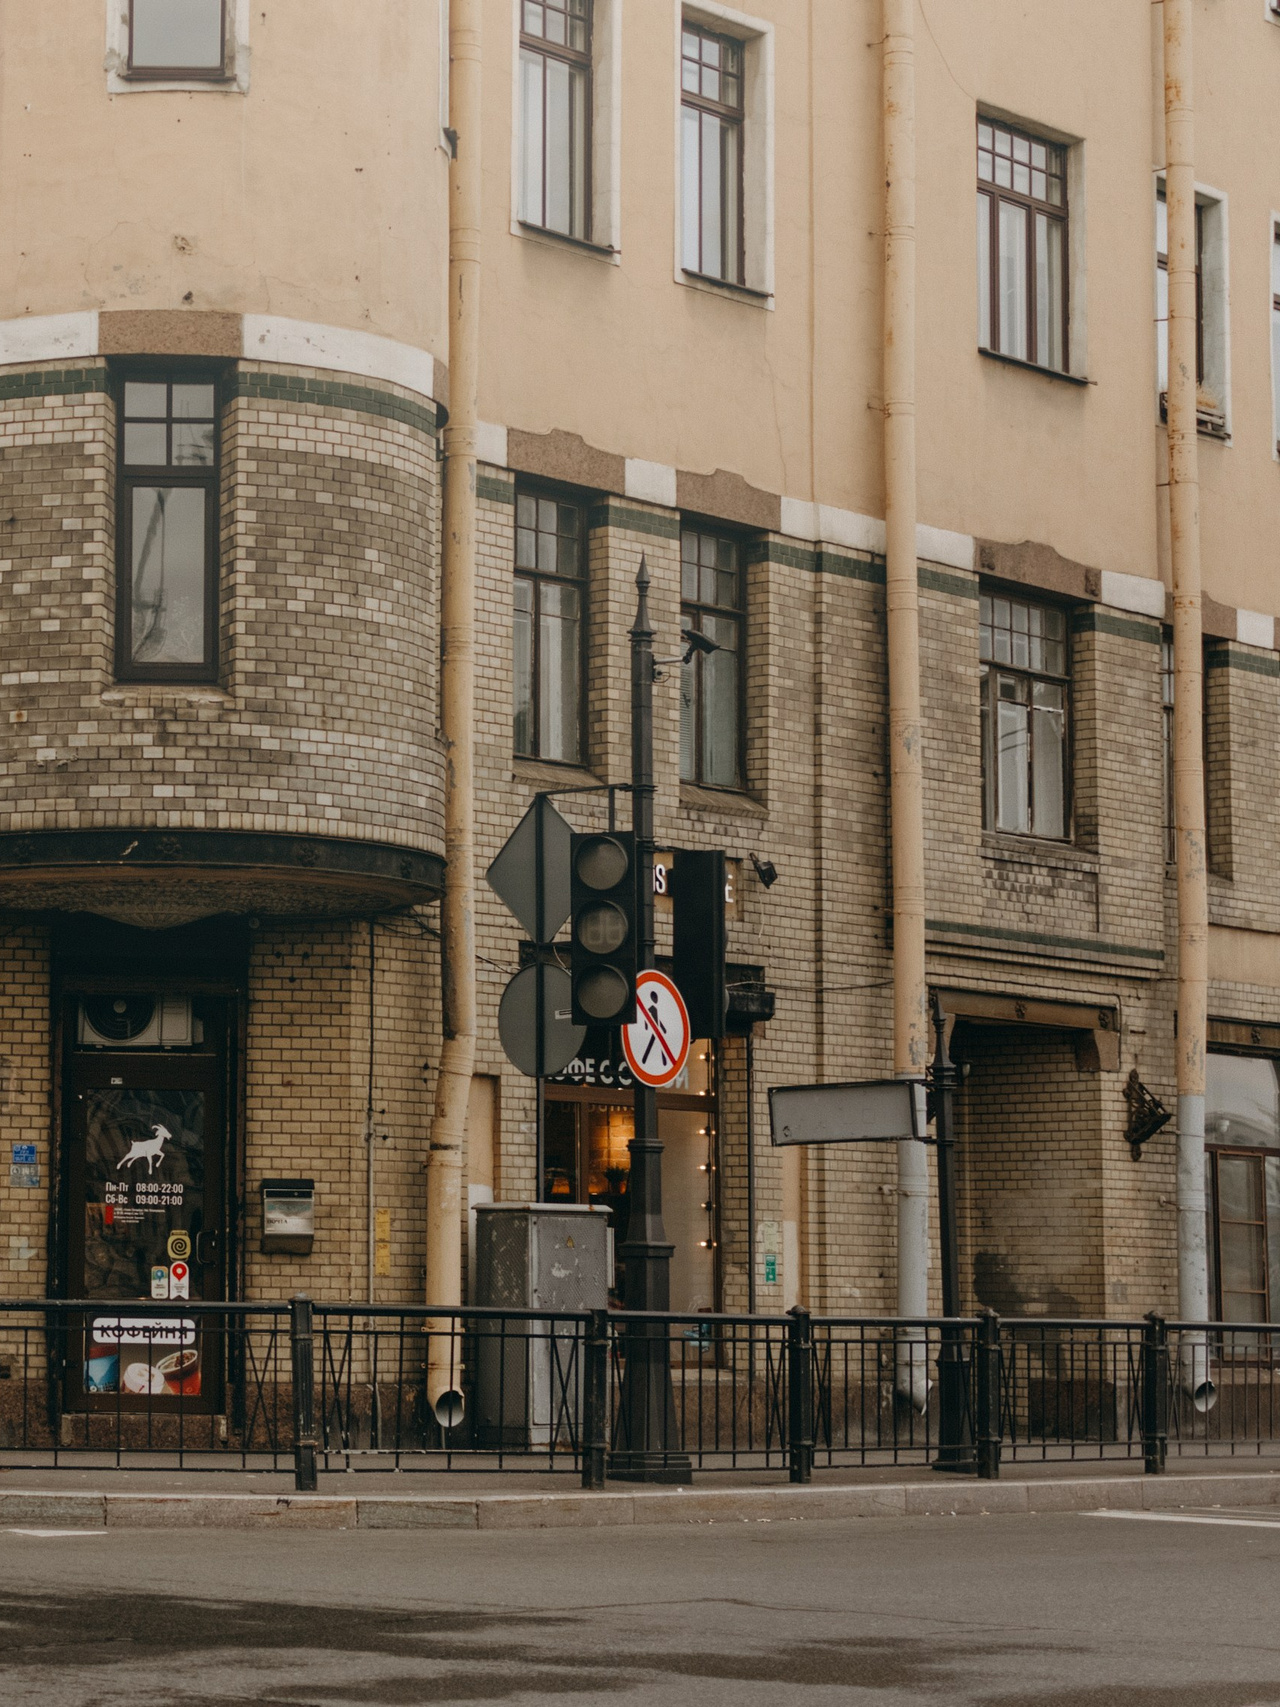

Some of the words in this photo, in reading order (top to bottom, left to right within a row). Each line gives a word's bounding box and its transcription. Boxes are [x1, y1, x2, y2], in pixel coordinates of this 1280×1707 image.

[105, 1182, 129, 1192] Пн-Пт
[135, 1183, 183, 1193] 08:00-22:00
[105, 1194, 128, 1204] Сб-Вс
[135, 1195, 183, 1205] 09:00-21:00
